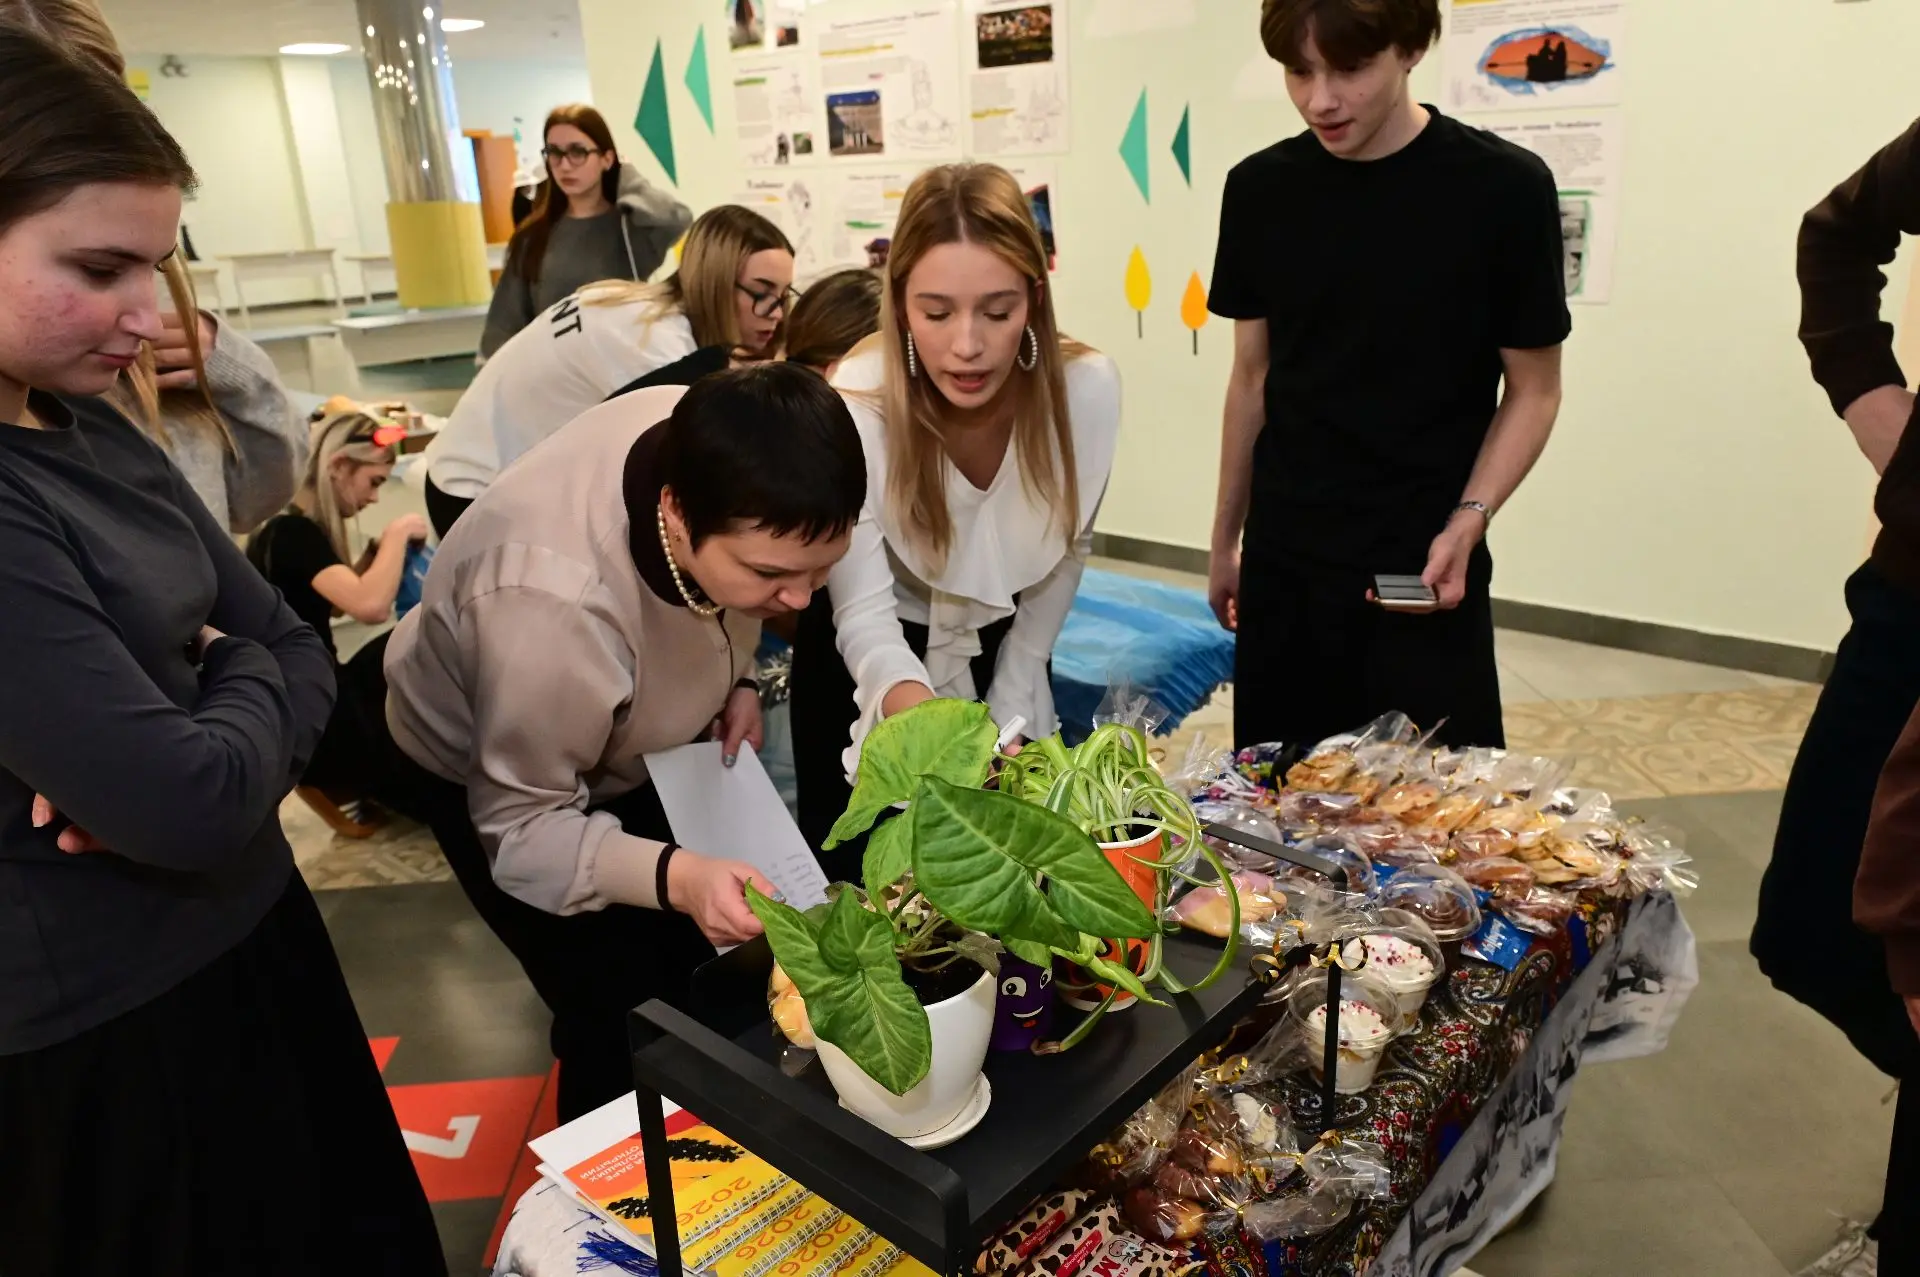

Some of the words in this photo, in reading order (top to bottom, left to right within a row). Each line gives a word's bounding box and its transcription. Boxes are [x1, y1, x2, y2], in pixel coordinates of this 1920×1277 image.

[605, 1163, 634, 1182] ЗАРЕ
[676, 1176, 752, 1226] 2026
[735, 1205, 812, 1260] 2026
[777, 1219, 852, 1276] 2026
